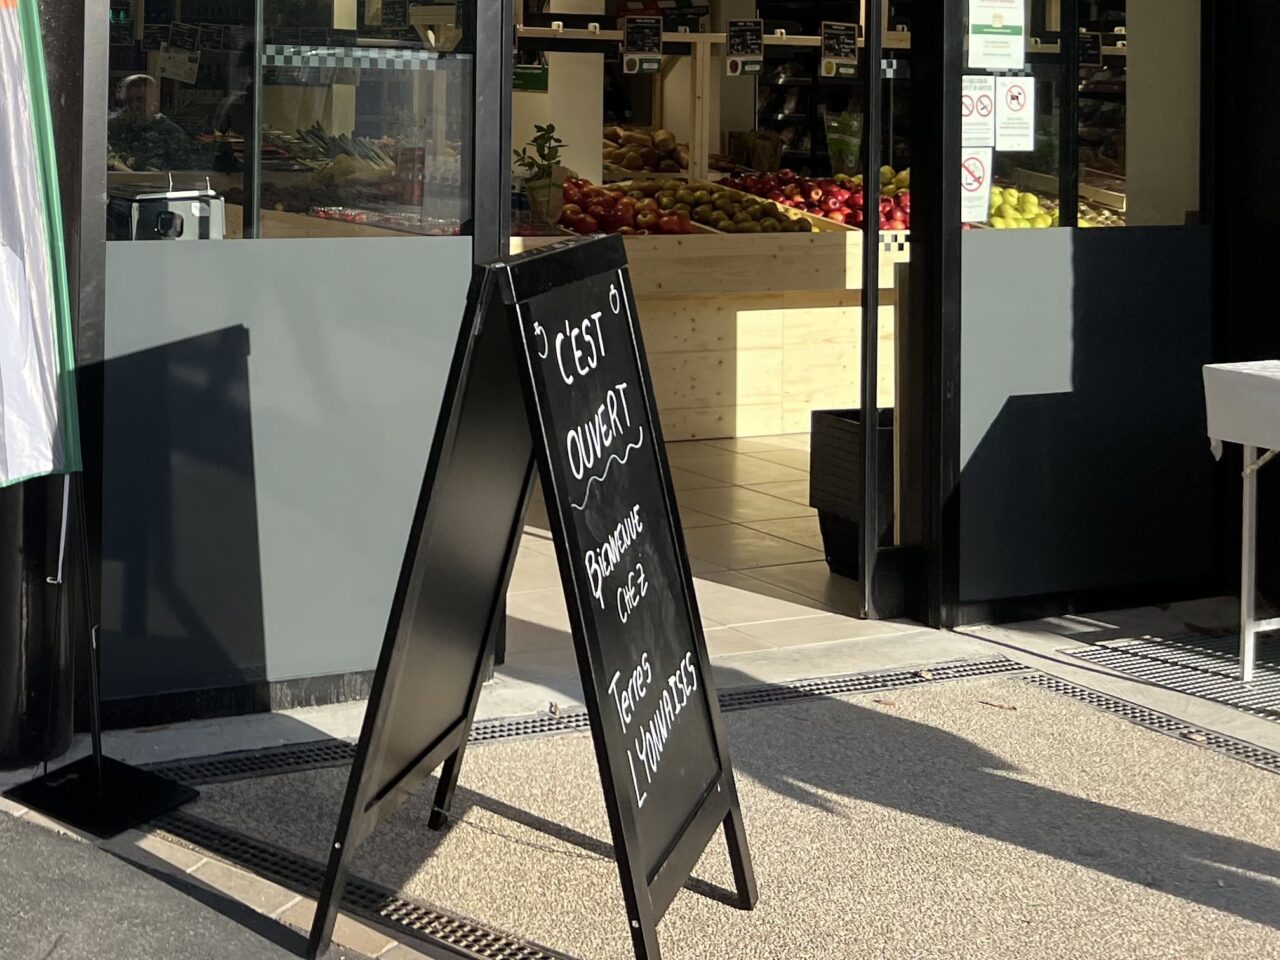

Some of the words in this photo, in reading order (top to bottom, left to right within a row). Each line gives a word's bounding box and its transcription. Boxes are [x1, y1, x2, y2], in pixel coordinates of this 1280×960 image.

[555, 311, 606, 385] C'EST
[566, 382, 631, 480] OUVERT
[608, 652, 652, 734] Terres
[627, 652, 697, 808] LYONNAISES
